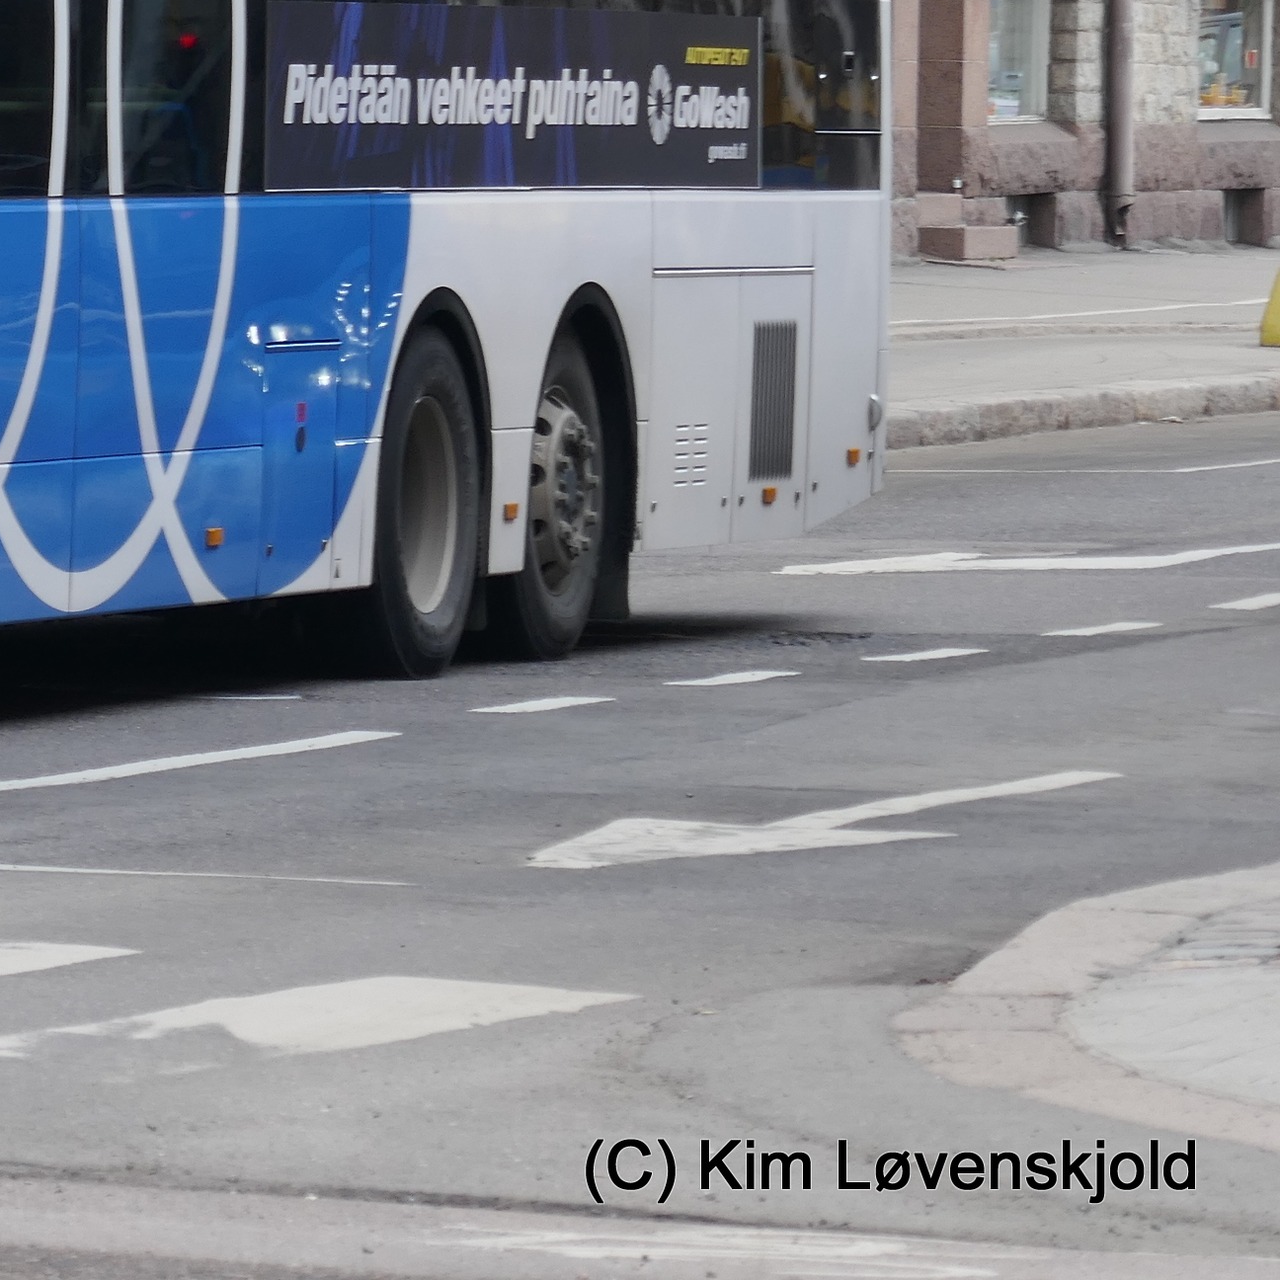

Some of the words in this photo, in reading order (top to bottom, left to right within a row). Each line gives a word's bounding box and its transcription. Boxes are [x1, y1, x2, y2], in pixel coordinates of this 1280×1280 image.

[283, 63, 410, 126] Pidetään
[416, 66, 525, 127] vehkeet
[526, 67, 639, 140] puhtaina
[673, 85, 751, 129] GoWash
